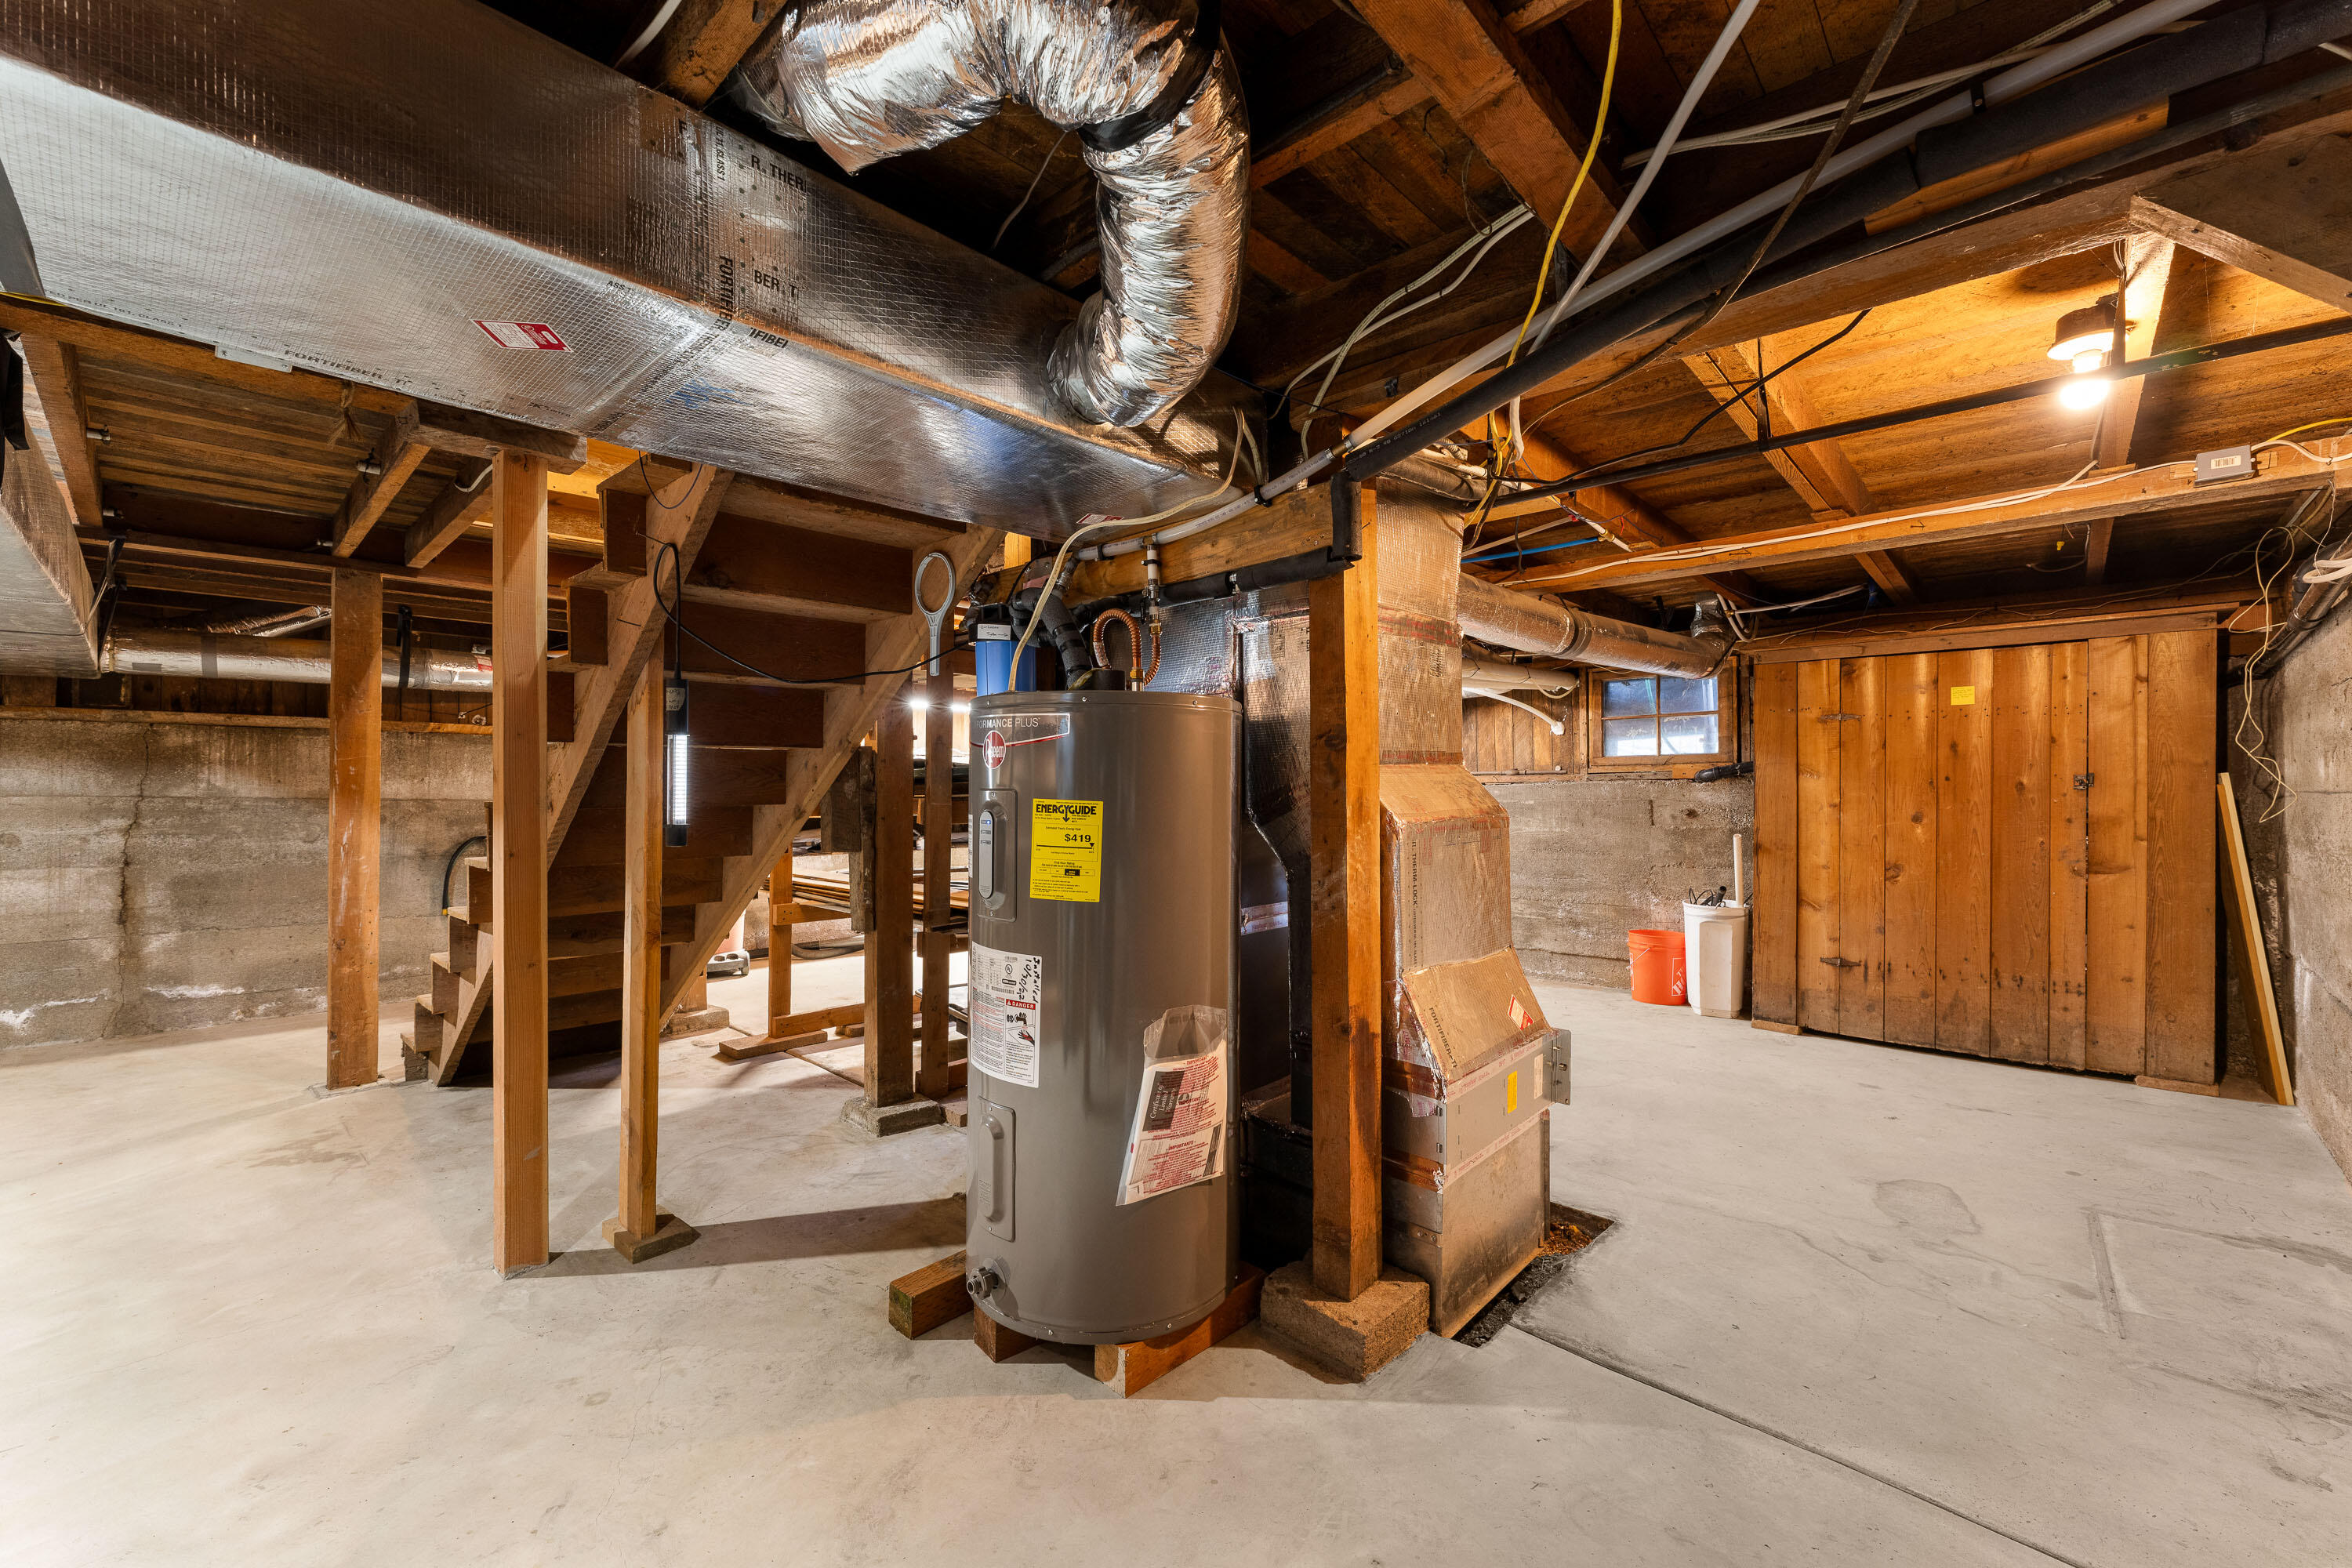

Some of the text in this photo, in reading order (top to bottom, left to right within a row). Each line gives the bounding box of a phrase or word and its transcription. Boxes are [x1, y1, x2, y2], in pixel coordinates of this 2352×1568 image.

[770, 163, 807, 192] THER
[715, 255, 734, 332] FORTIFIBER
[138, 314, 175, 326] CLASS
[748, 327, 789, 349] IFIBE
[284, 350, 384, 379] FORTIFIBER
[1014, 717, 1039, 728] PLUS
[1036, 804, 1097, 815] ENERGYGUIDE
[1065, 833, 1091, 843] $419
[1428, 1007, 1452, 1056] FORTIFIBER
[1168, 1140, 1194, 1150] IMPORTANTE
